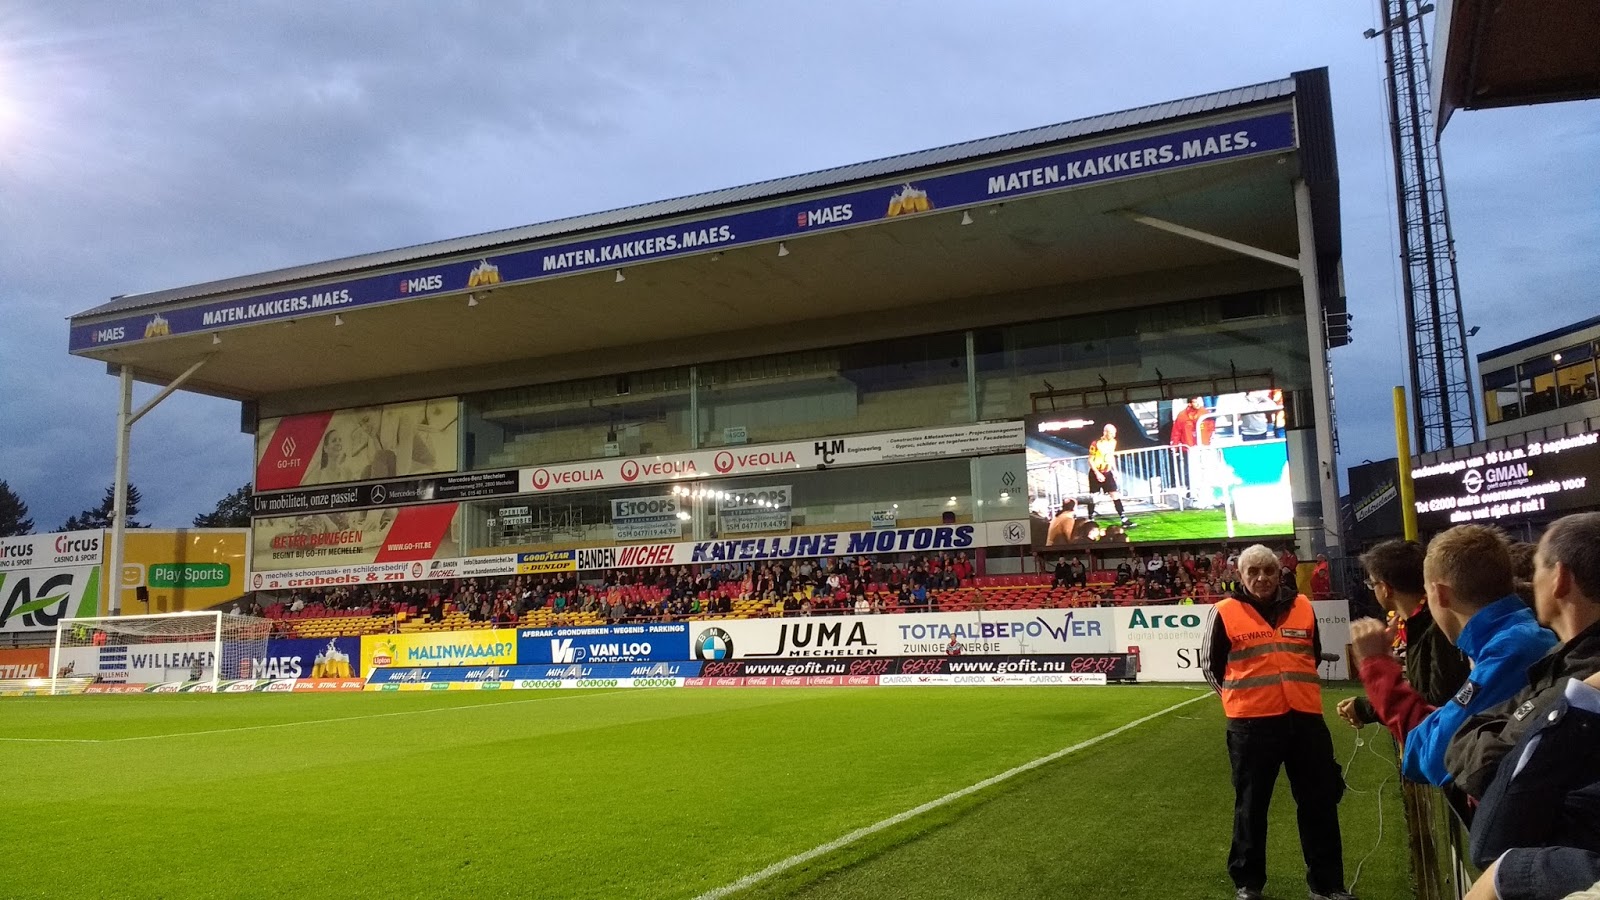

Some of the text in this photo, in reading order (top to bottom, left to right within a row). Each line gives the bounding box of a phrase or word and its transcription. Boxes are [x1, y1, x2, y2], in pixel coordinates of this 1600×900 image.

[987, 130, 1257, 194] MATEN.KAKKERS.MAES.
[807, 204, 853, 226] MAES
[543, 225, 736, 271] MATEN.KAKKERS.MAES.
[408, 274, 443, 293] MAES
[203, 289, 352, 326] MATEN.KAKKERS.MAES.
[98, 326, 125, 343] MAES
[961, 443, 1026, 452] www.hmc-engineering.
[1543, 433, 1599, 454] september
[277, 458, 301, 469] GO-FIT
[737, 451, 796, 467] VEOLIA
[641, 460, 697, 475] VEOLIA
[552, 468, 604, 484] VEOLIA
[254, 488, 358, 511] Uw mobiliteit, onze passie!
[389, 487, 429, 499] Mercedes-Ben
[1415, 501, 1429, 513] Tot
[1562, 476, 1587, 490] voor
[500, 507, 528, 516] OPENING
[618, 499, 675, 516] STOOPS
[503, 516, 532, 525] OKTOBER
[55, 535, 98, 553] Circus
[273, 530, 363, 549] BETER BEWEGEN
[387, 541, 432, 551] WWW.GO-FIT.BE
[692, 525, 974, 562] KATELIJNE MOTORS
[272, 551, 294, 559] BEGINT
[306, 549, 327, 557] GO-FIT
[523, 552, 569, 562] GOODYEAR
[578, 544, 674, 570] BANDEN MICHEL
[265, 571, 294, 579] mechels
[295, 568, 342, 578] schoonmaak-
[353, 563, 409, 574] schildersbedrijf
[442, 560, 458, 568] BANDEN
[463, 566, 514, 575] www.bandenmichel.be
[530, 563, 570, 571] DUNLOP
[155, 567, 224, 583] Play Sports
[269, 572, 405, 588] a. crabeels & zn
[428, 569, 455, 578] MICHEL
[0, 574, 74, 628] AG
[1128, 608, 1200, 629] Arco
[1317, 616, 1347, 624] ne.be
[557, 628, 609, 636] GRONDWERKEN
[613, 626, 644, 634] WEGENIS
[649, 625, 685, 633] PARKINGS
[699, 628, 730, 642] BMW
[899, 611, 1101, 643] TOTAALBEPOWER
[744, 621, 869, 657] JUMA
[1128, 631, 1200, 641] digital paperflow
[1232, 631, 1273, 643] STEWARD
[408, 642, 512, 660] MALINWAAAR?
[590, 643, 651, 656] VAN LOO
[789, 649, 877, 657] MECHELEN
[903, 642, 1000, 653] ZUINIGE NERGIE
[131, 652, 215, 669] WILLEMEN
[252, 656, 302, 679] MAES
[949, 659, 1065, 674] www.gofit.nu
[745, 662, 845, 676] www.gofit.nu
[1029, 675, 1063, 683] CAIROX
